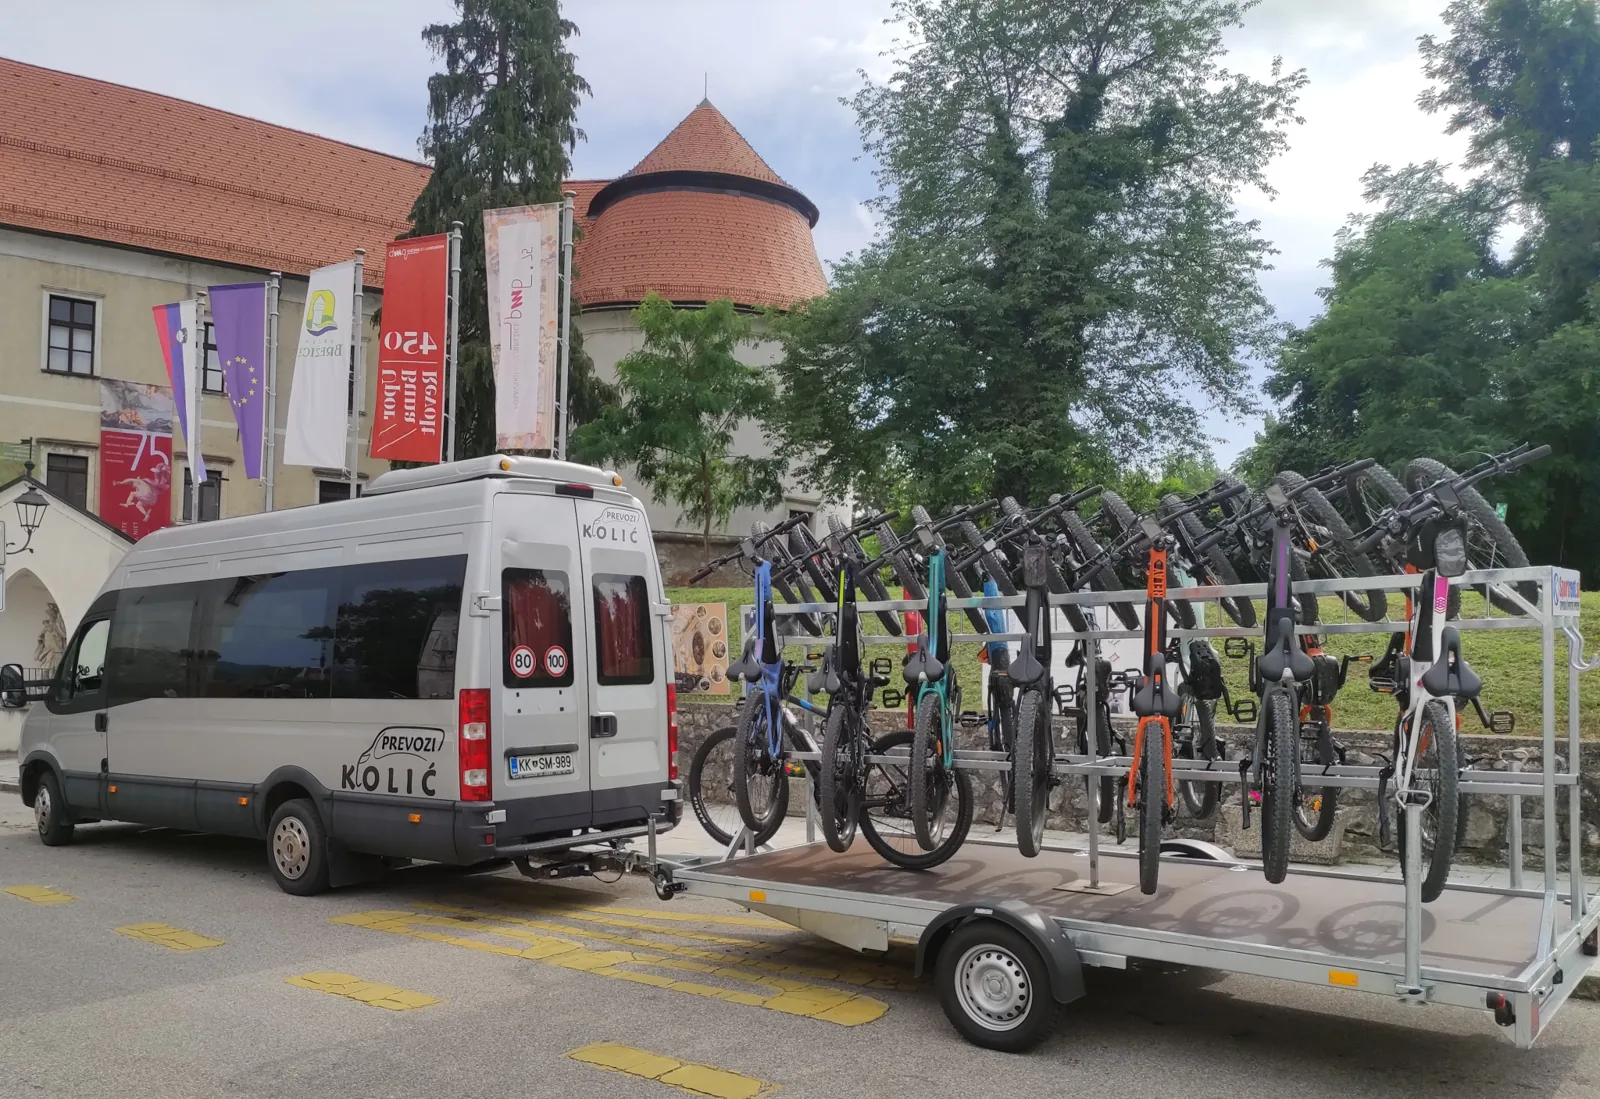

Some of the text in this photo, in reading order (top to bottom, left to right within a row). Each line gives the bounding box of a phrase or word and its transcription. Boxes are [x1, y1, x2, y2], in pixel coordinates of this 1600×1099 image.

[606, 511, 636, 522] PREVOZI
[582, 524, 638, 544] KOLIĆ
[515, 653, 532, 668] 80
[548, 654, 565, 668] 100
[381, 736, 436, 752] PREVOZI
[519, 755, 572, 771] KK SM-989
[341, 762, 437, 797] KOLIĆ
